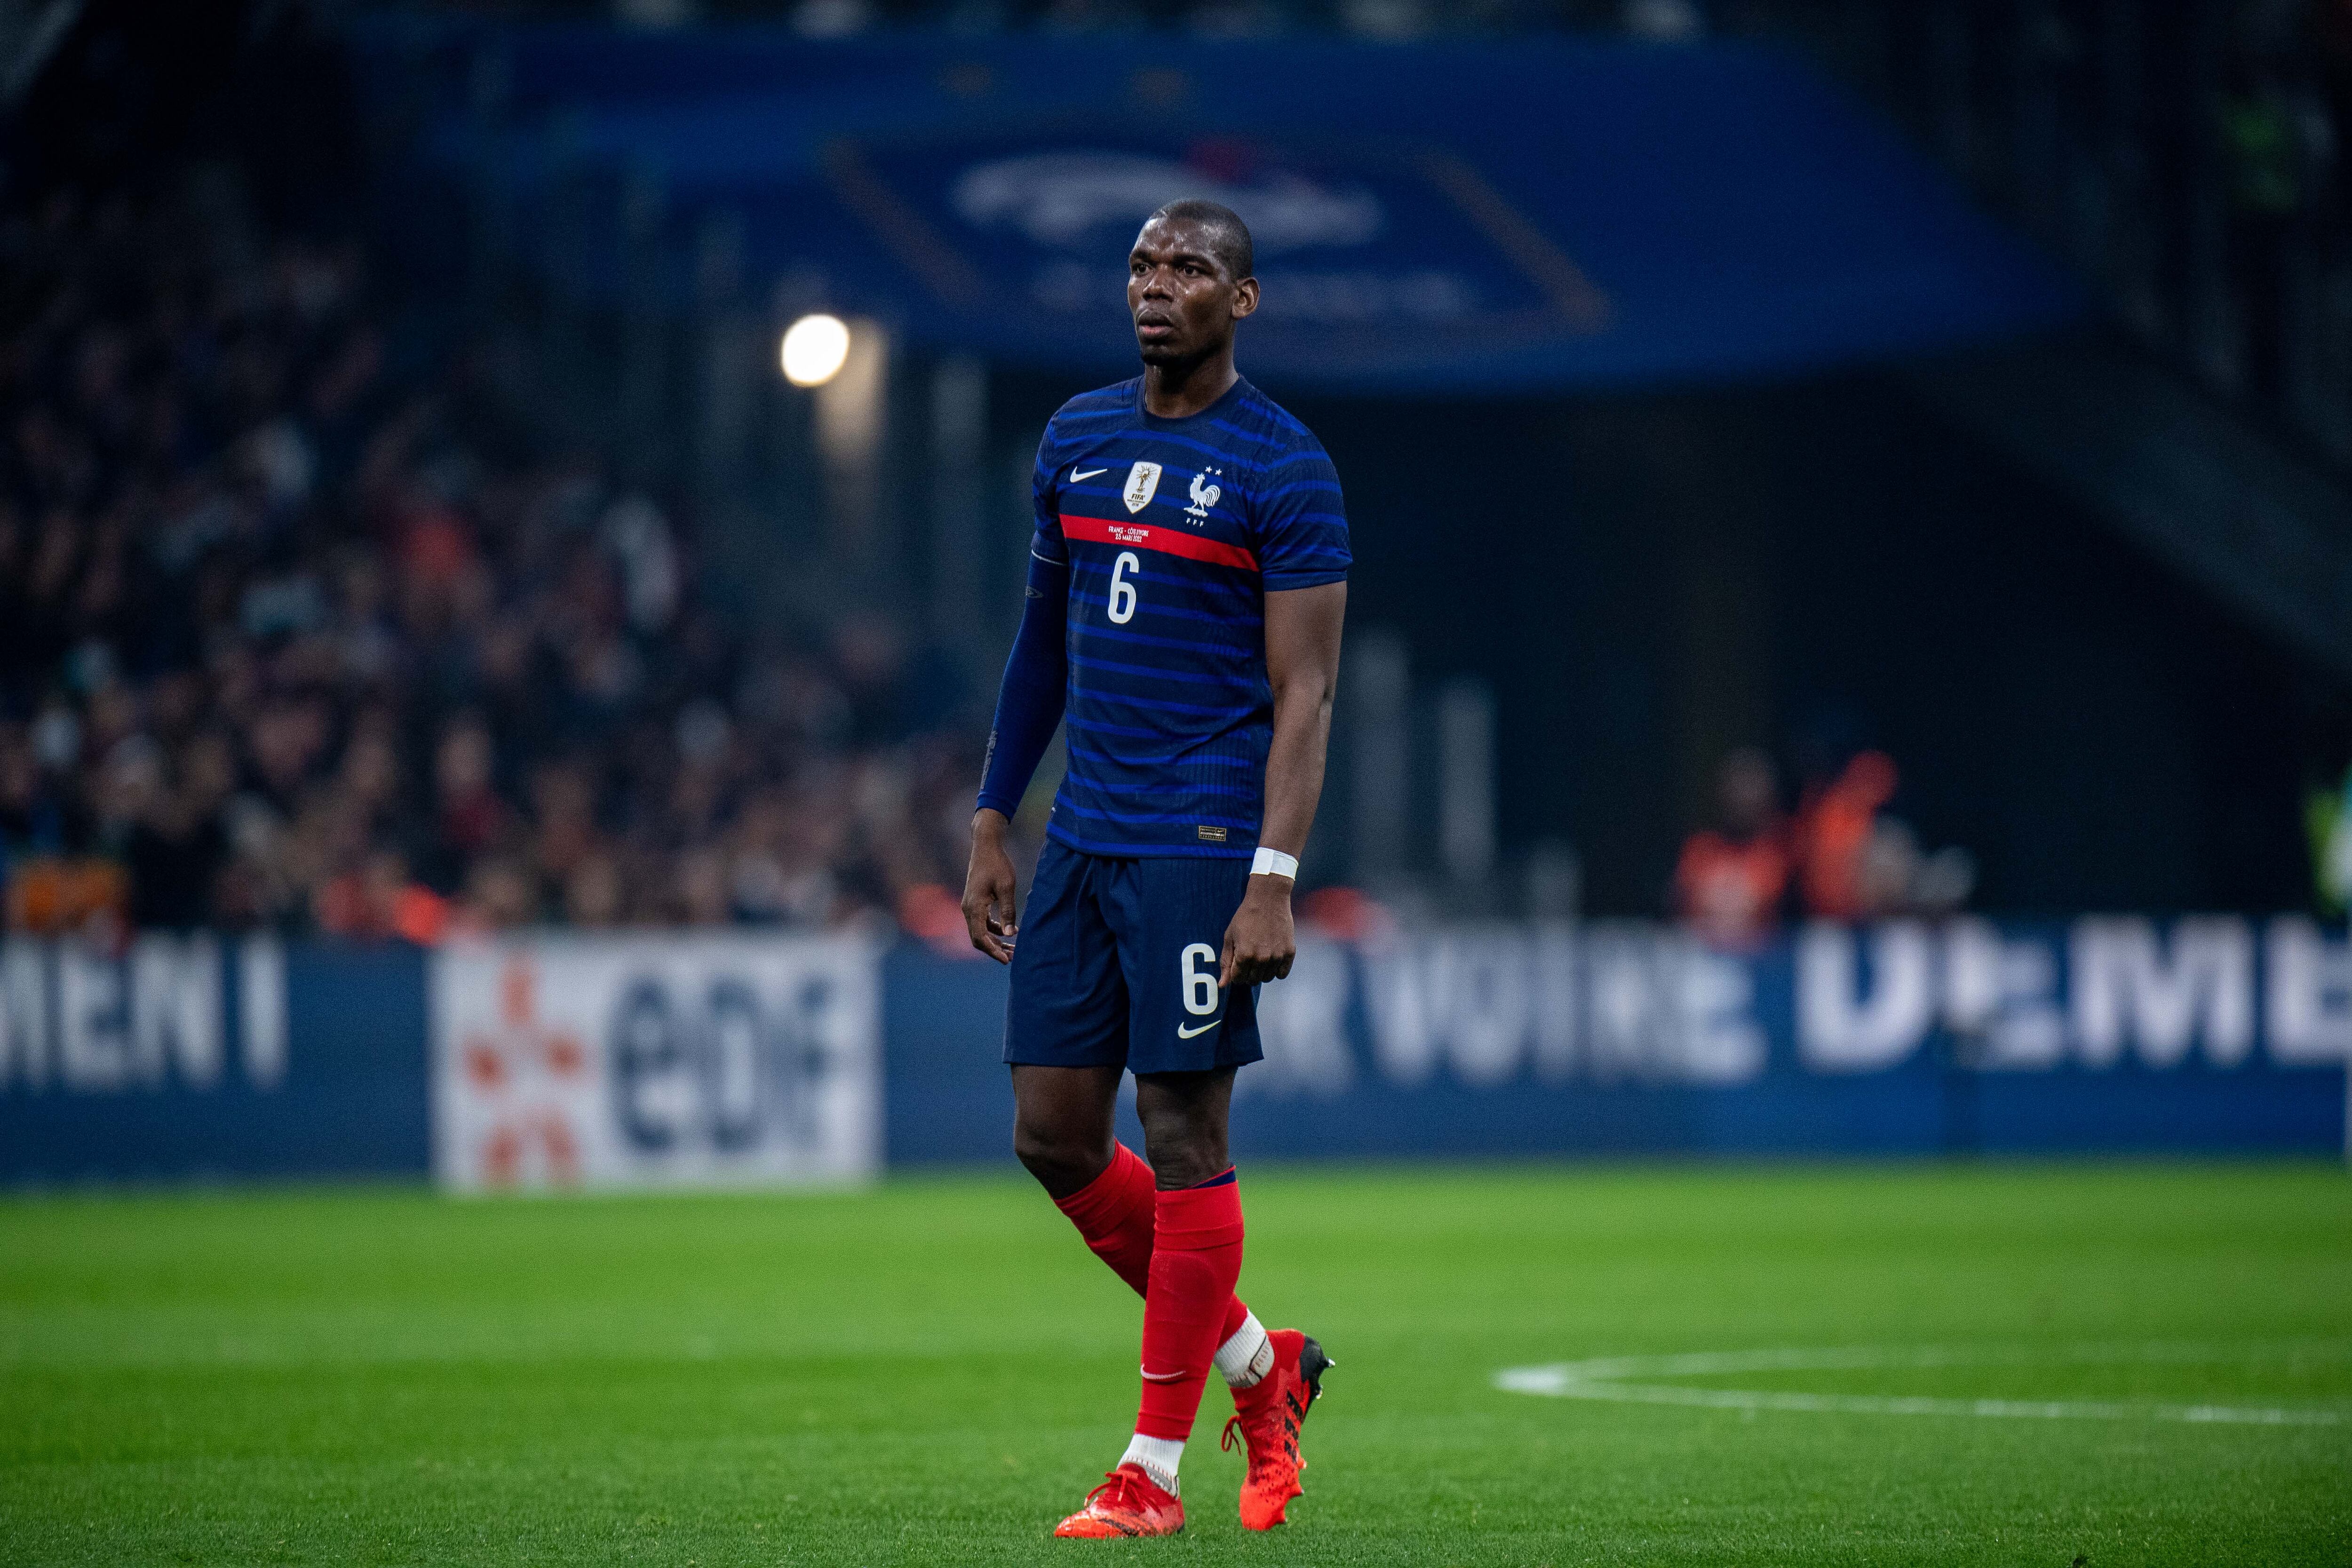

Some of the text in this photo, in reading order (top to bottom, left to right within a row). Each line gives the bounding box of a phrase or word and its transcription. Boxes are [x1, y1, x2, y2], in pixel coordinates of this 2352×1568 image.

[1108, 525, 1123, 534] FRANCE
[1108, 551, 1139, 624] 6
[1181, 943, 1218, 1015] 6
